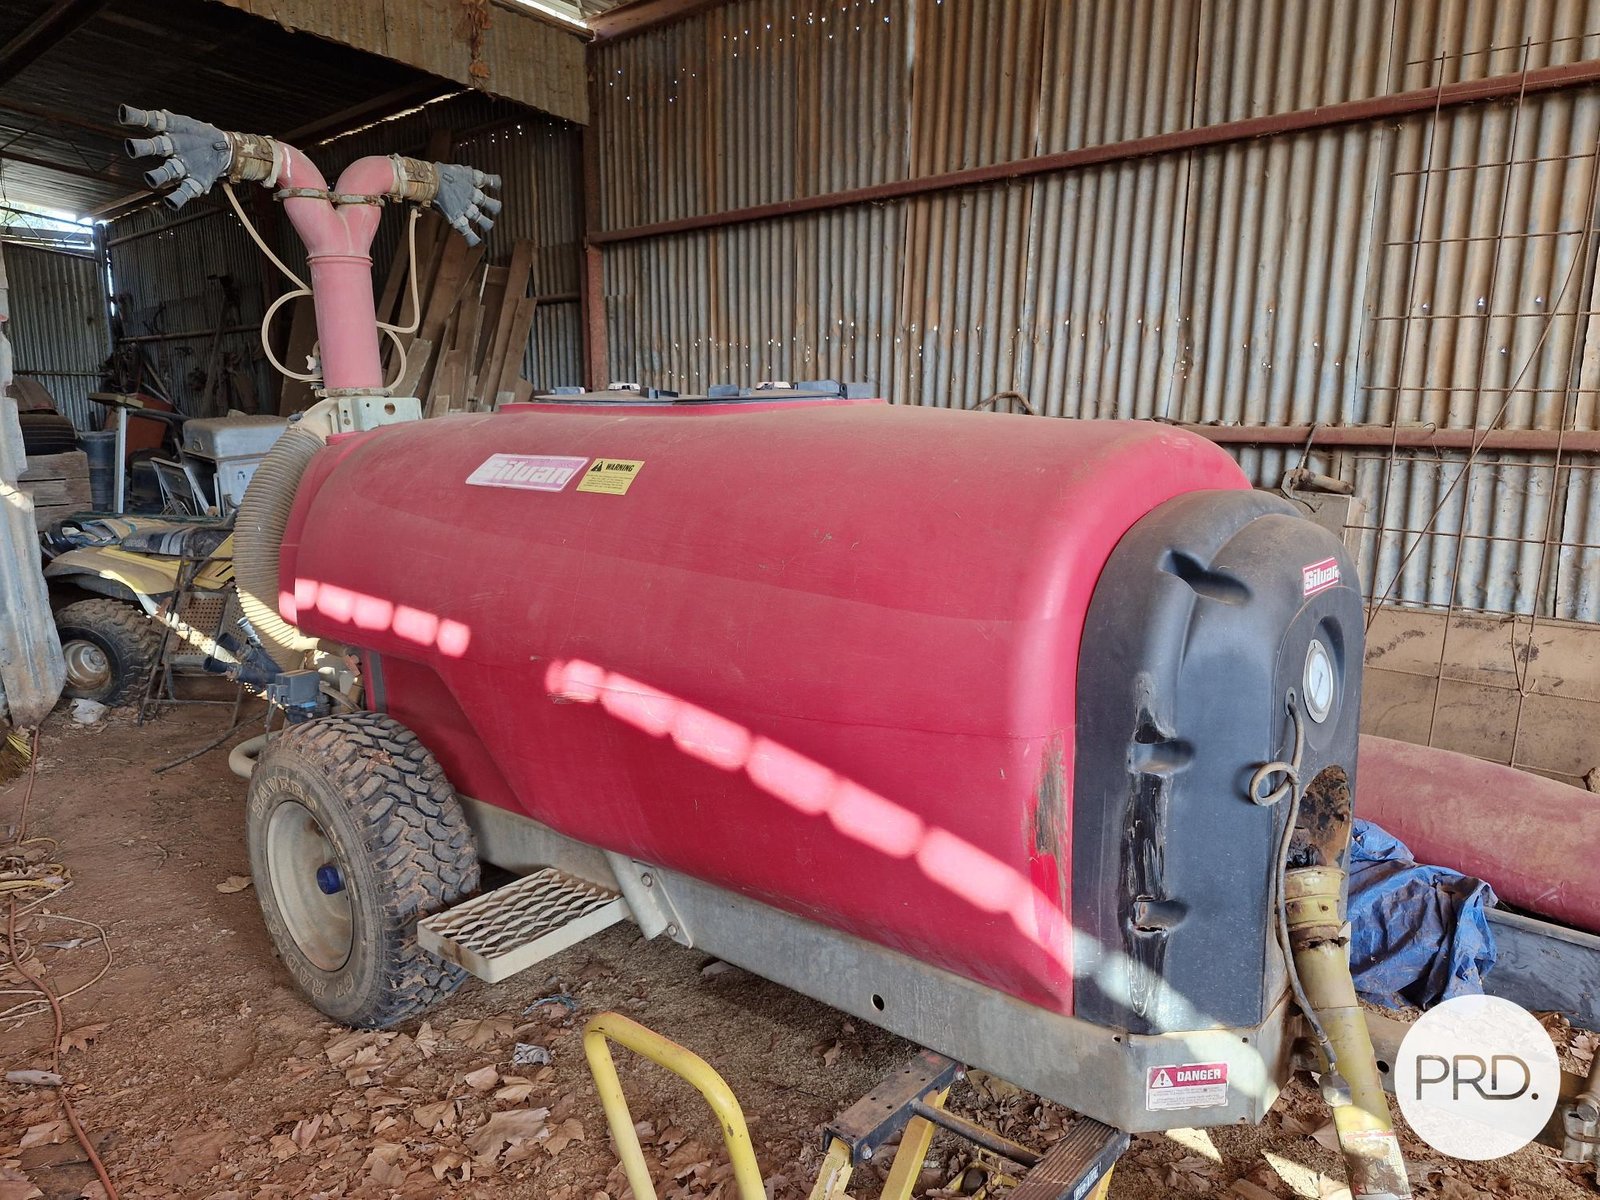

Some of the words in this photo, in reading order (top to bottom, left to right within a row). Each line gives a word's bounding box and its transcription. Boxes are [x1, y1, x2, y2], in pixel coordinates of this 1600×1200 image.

[605, 463, 635, 472] WARNING
[251, 775, 317, 819] SAVERO
[260, 895, 328, 999] RADIAL
[1176, 1068, 1221, 1082] DANGER
